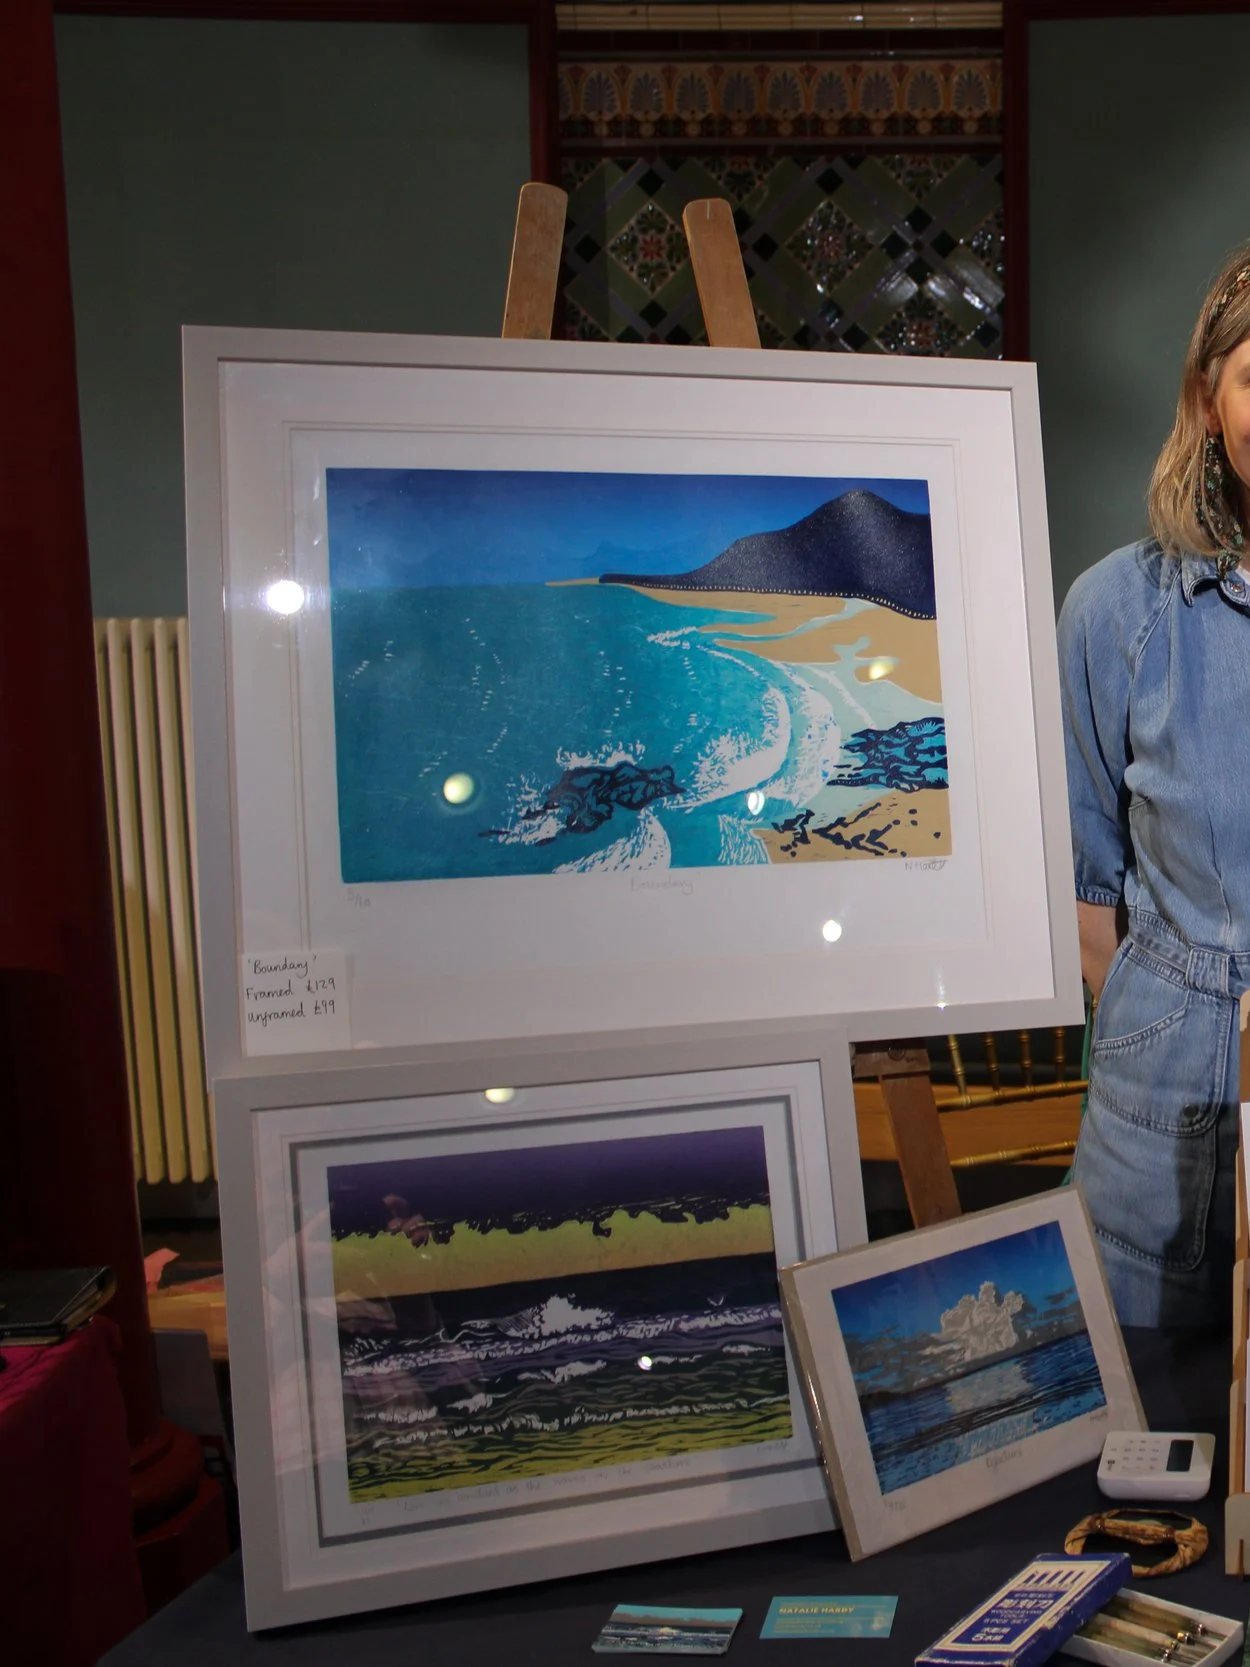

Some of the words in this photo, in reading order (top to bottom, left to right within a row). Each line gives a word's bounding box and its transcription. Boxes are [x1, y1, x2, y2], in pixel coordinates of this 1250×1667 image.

[246, 979, 294, 1000] Framed
[306, 977, 336, 994] £129
[314, 999, 335, 1015] £99
